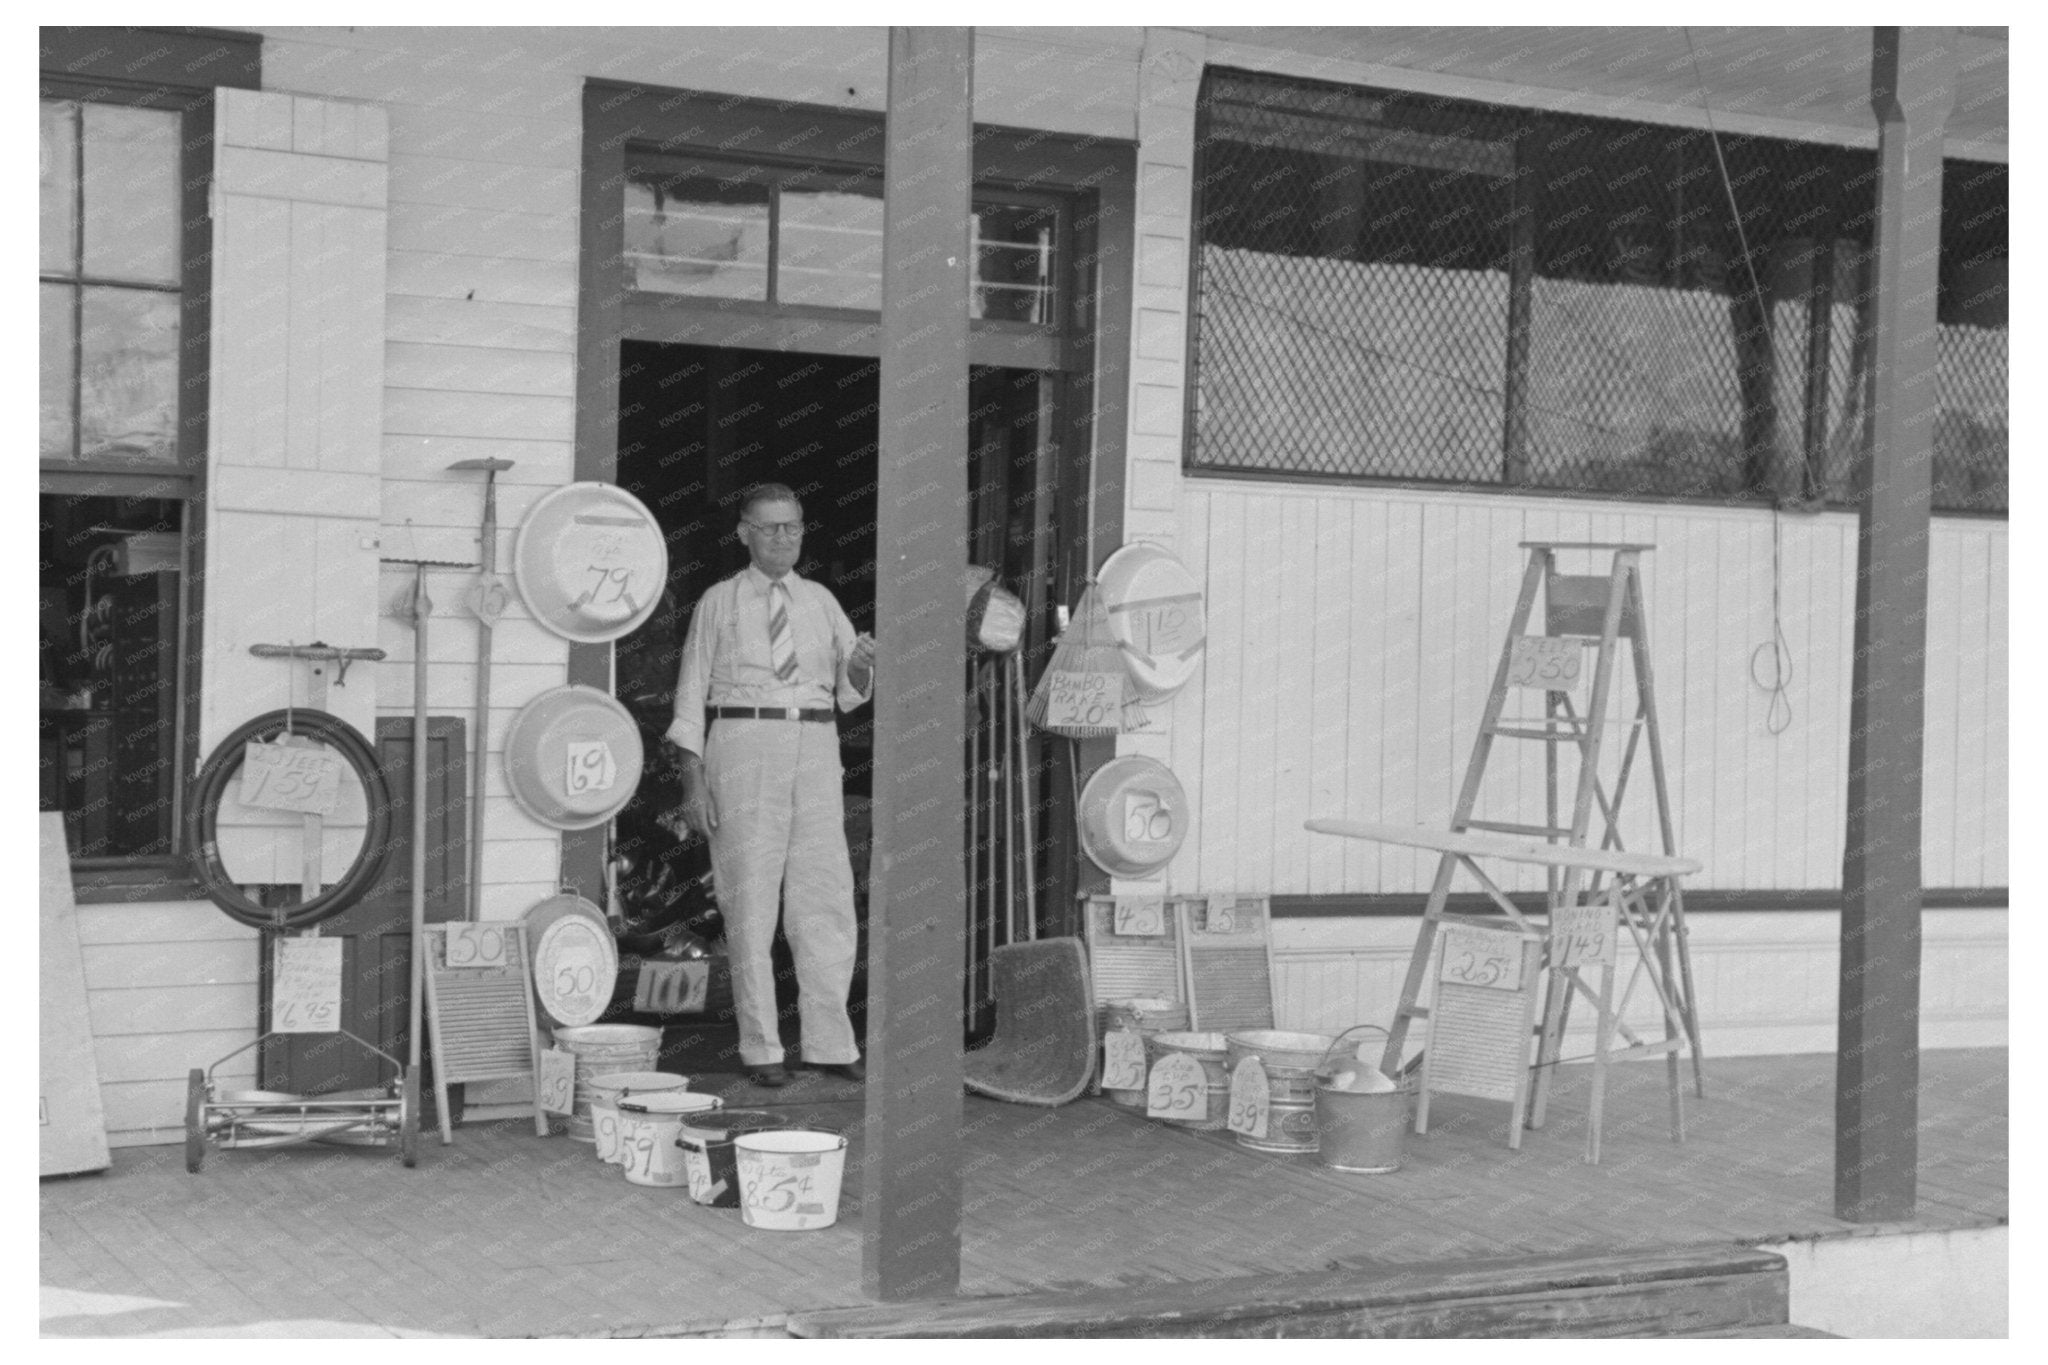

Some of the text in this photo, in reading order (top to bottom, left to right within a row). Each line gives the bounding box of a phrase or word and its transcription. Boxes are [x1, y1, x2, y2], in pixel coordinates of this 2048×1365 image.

[1054, 690, 1105, 706] RAKE
[572, 749, 605, 790] 69
[557, 966, 594, 996] 50
